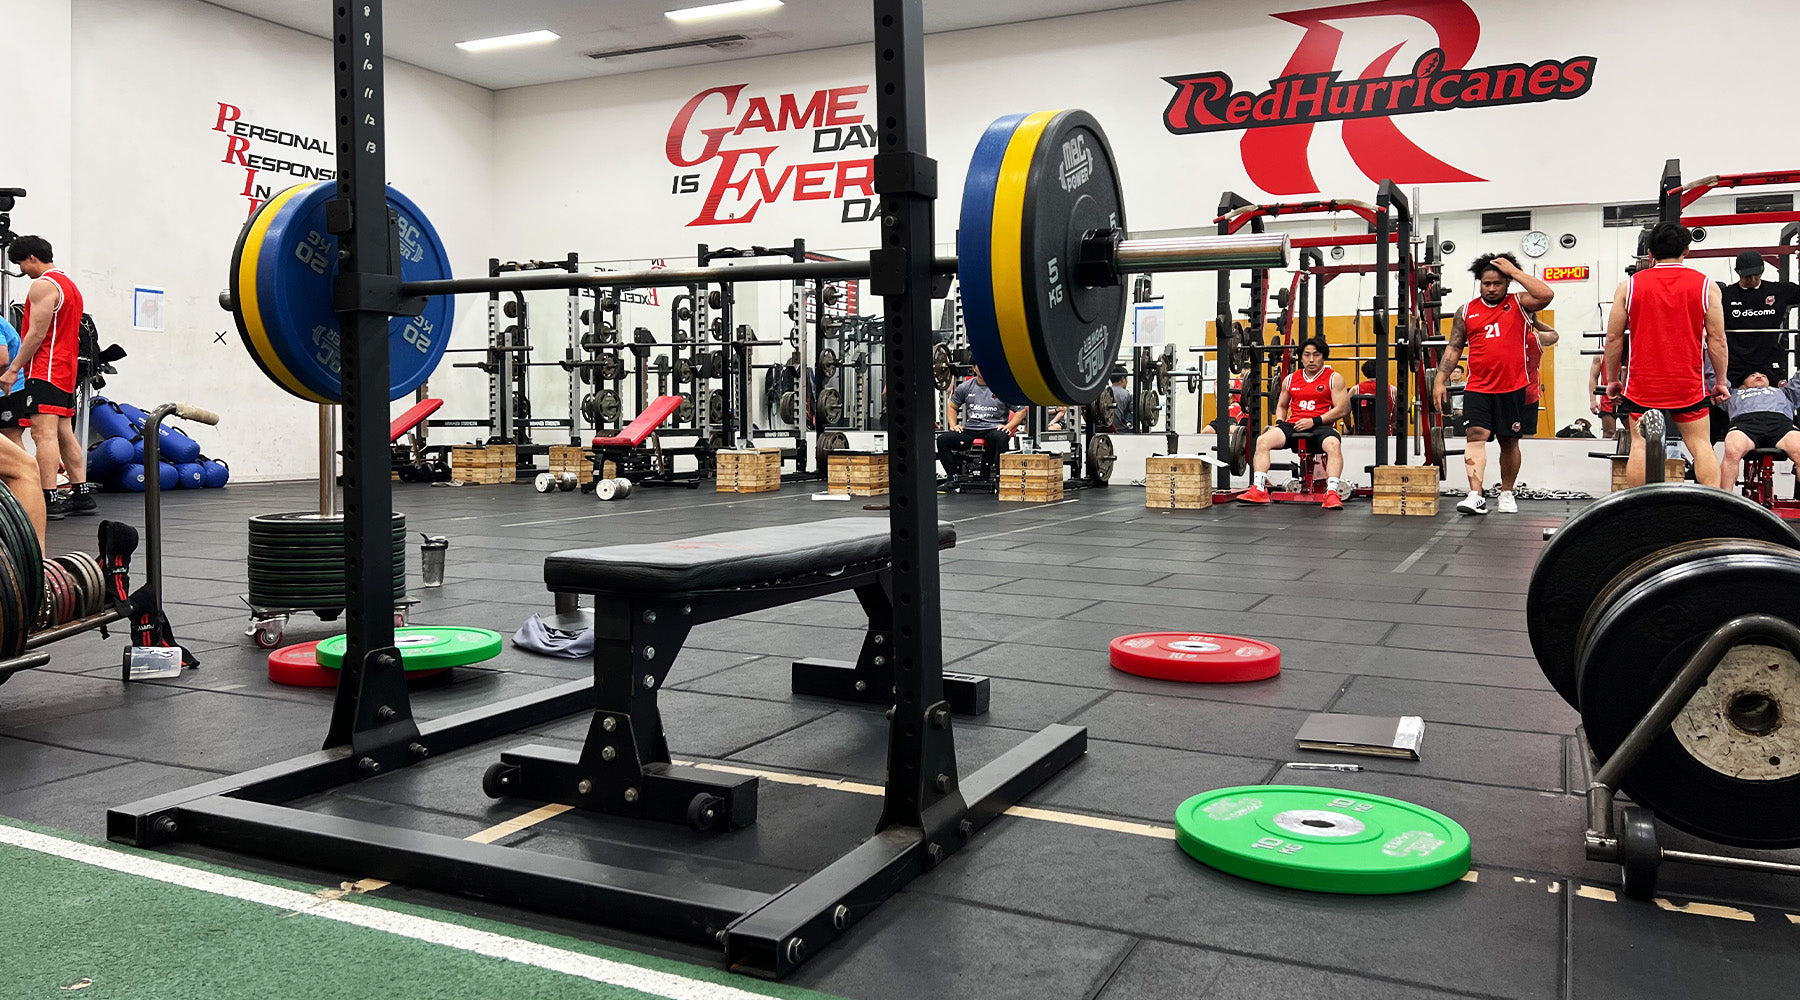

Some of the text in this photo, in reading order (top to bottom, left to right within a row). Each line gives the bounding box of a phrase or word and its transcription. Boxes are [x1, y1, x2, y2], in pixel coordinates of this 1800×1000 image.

[364, 5, 371, 17] 8
[364, 32, 371, 46] 9
[363, 58, 373, 71] 10
[364, 87, 374, 99] 11
[1160, 48, 1597, 135] RedHurricanes
[212, 101, 335, 156] PERSONAL
[364, 113, 376, 126] 12
[665, 83, 869, 168] GAME
[365, 141, 377, 153] 13
[221, 134, 338, 181] RESPONSI
[672, 145, 876, 228] IS EVER
[398, 215, 420, 248] BC
[1047, 257, 1059, 284] 5
[1048, 284, 1063, 309] KG
[1484, 322, 1501, 339] 21
[1299, 400, 1316, 411] 96
[1326, 798, 1356, 809] 10
[1251, 837, 1305, 856] 10 KG
